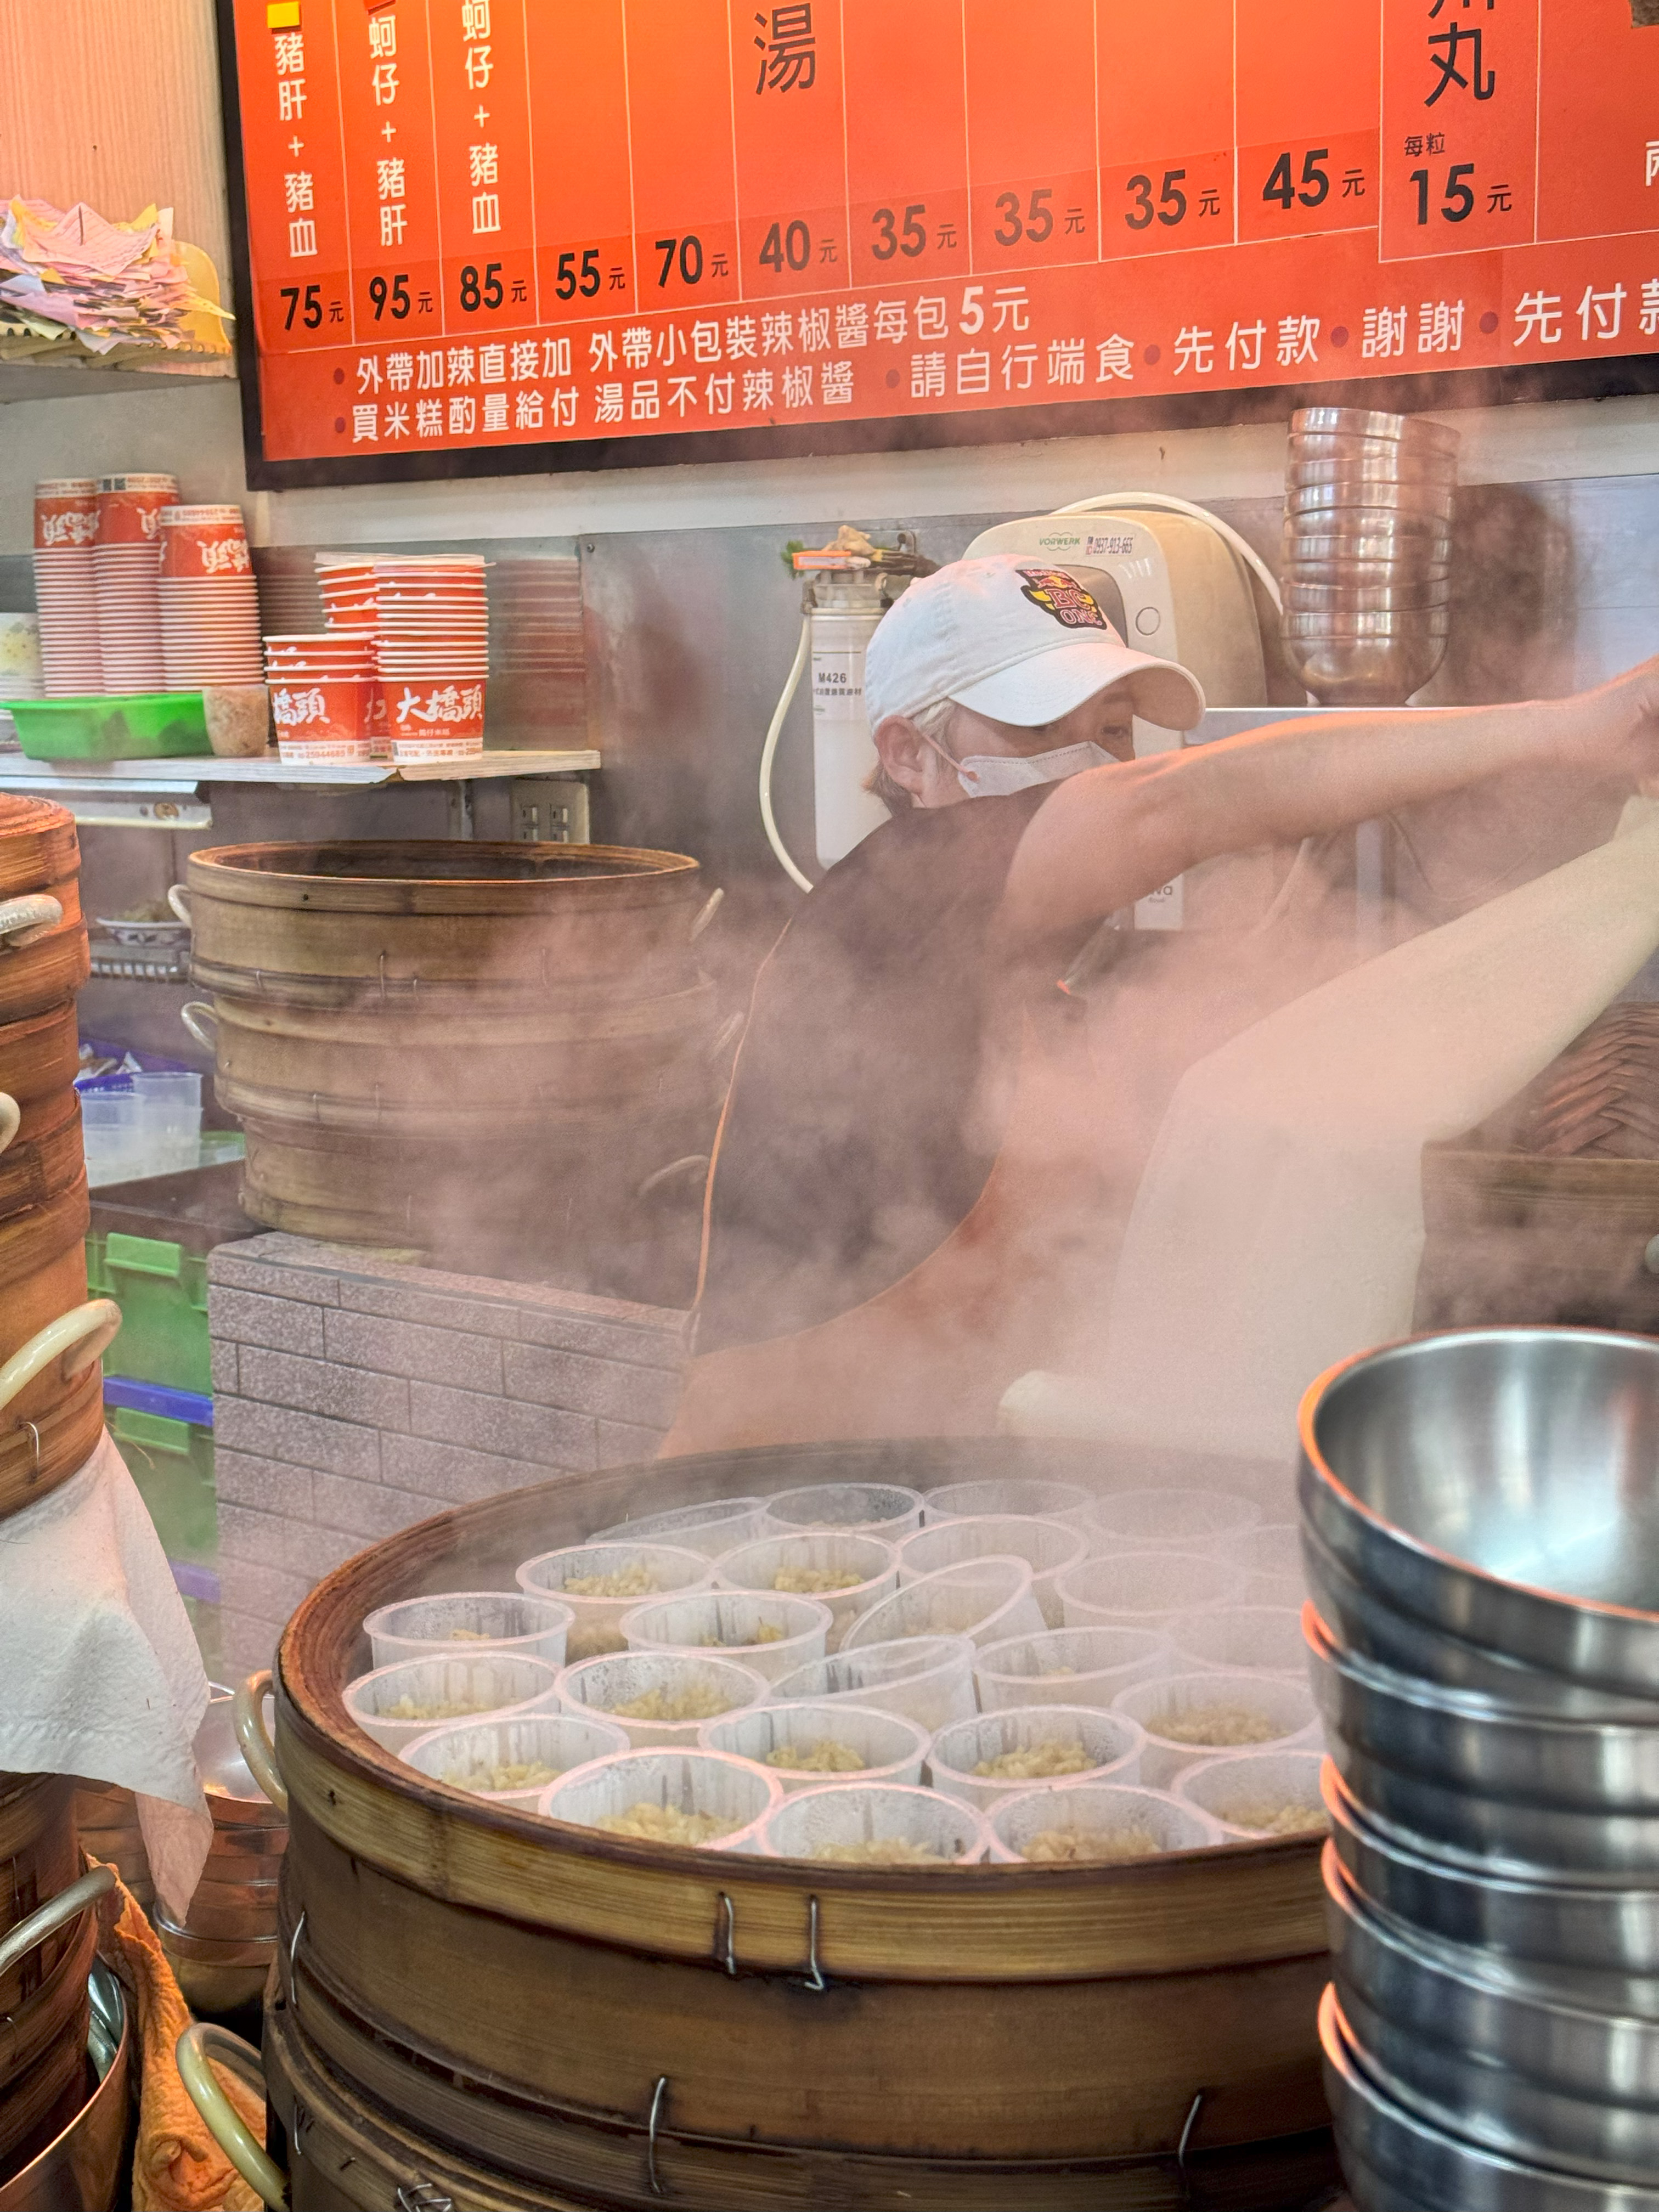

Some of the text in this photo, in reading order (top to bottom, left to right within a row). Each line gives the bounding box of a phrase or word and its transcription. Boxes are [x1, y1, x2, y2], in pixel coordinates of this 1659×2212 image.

[754, 3, 816, 95] 湯
[1424, 0, 1496, 108] 丸
[1404, 133, 1446, 157] 每粒
[352, 388, 579, 443] 買米糕酌量給付
[595, 360, 854, 424] 湯品不付辣椒醬
[911, 333, 1135, 398] 請自行端食
[1173, 316, 1321, 376] 先付款
[1363, 300, 1465, 359] 謝謝
[357, 338, 571, 394] 外帶加辣直接加
[1039, 538, 1081, 546] VORWERK
[1043, 588, 1091, 610] BC
[1059, 608, 1103, 626] ONE
[818, 672, 847, 684] M426
[396, 684, 483, 724] 大橋頭
